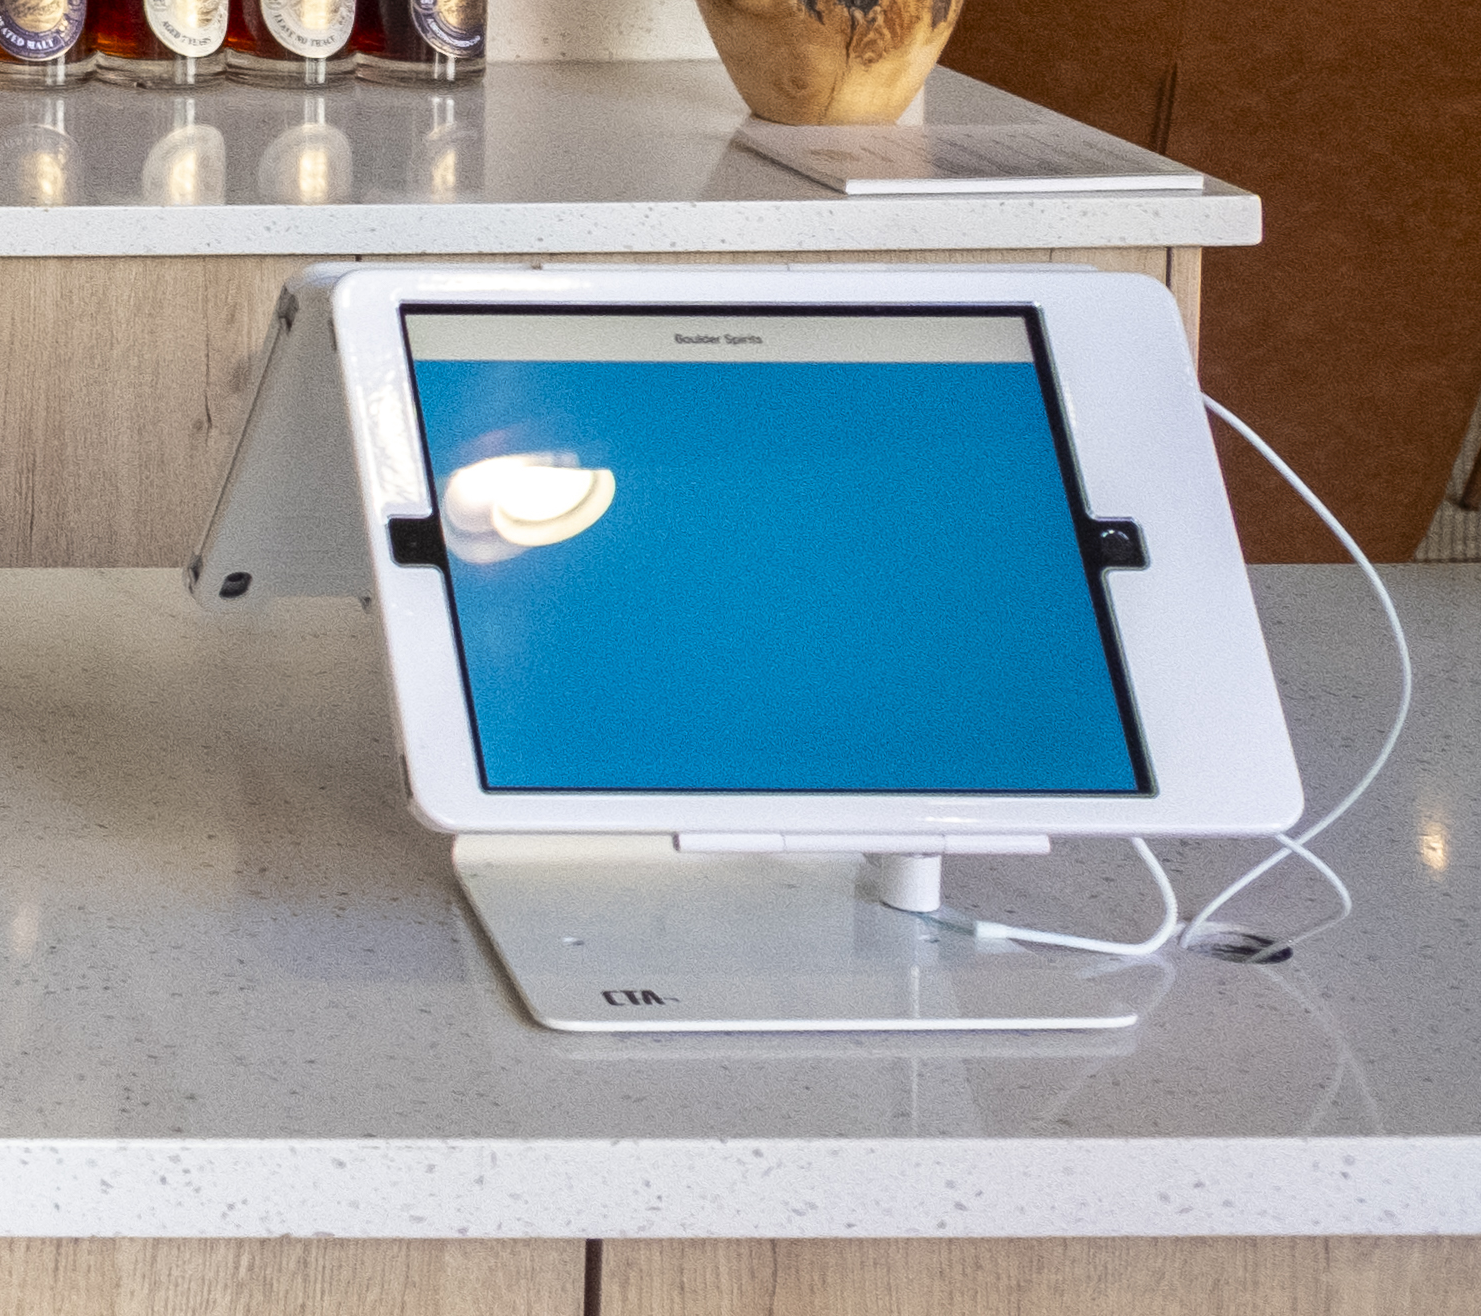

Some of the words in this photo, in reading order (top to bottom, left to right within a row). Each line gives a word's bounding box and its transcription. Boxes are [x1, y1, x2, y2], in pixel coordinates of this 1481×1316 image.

[675, 333, 721, 344] Boulder
[724, 333, 763, 344] Spirits
[601, 989, 666, 1006] CTA
